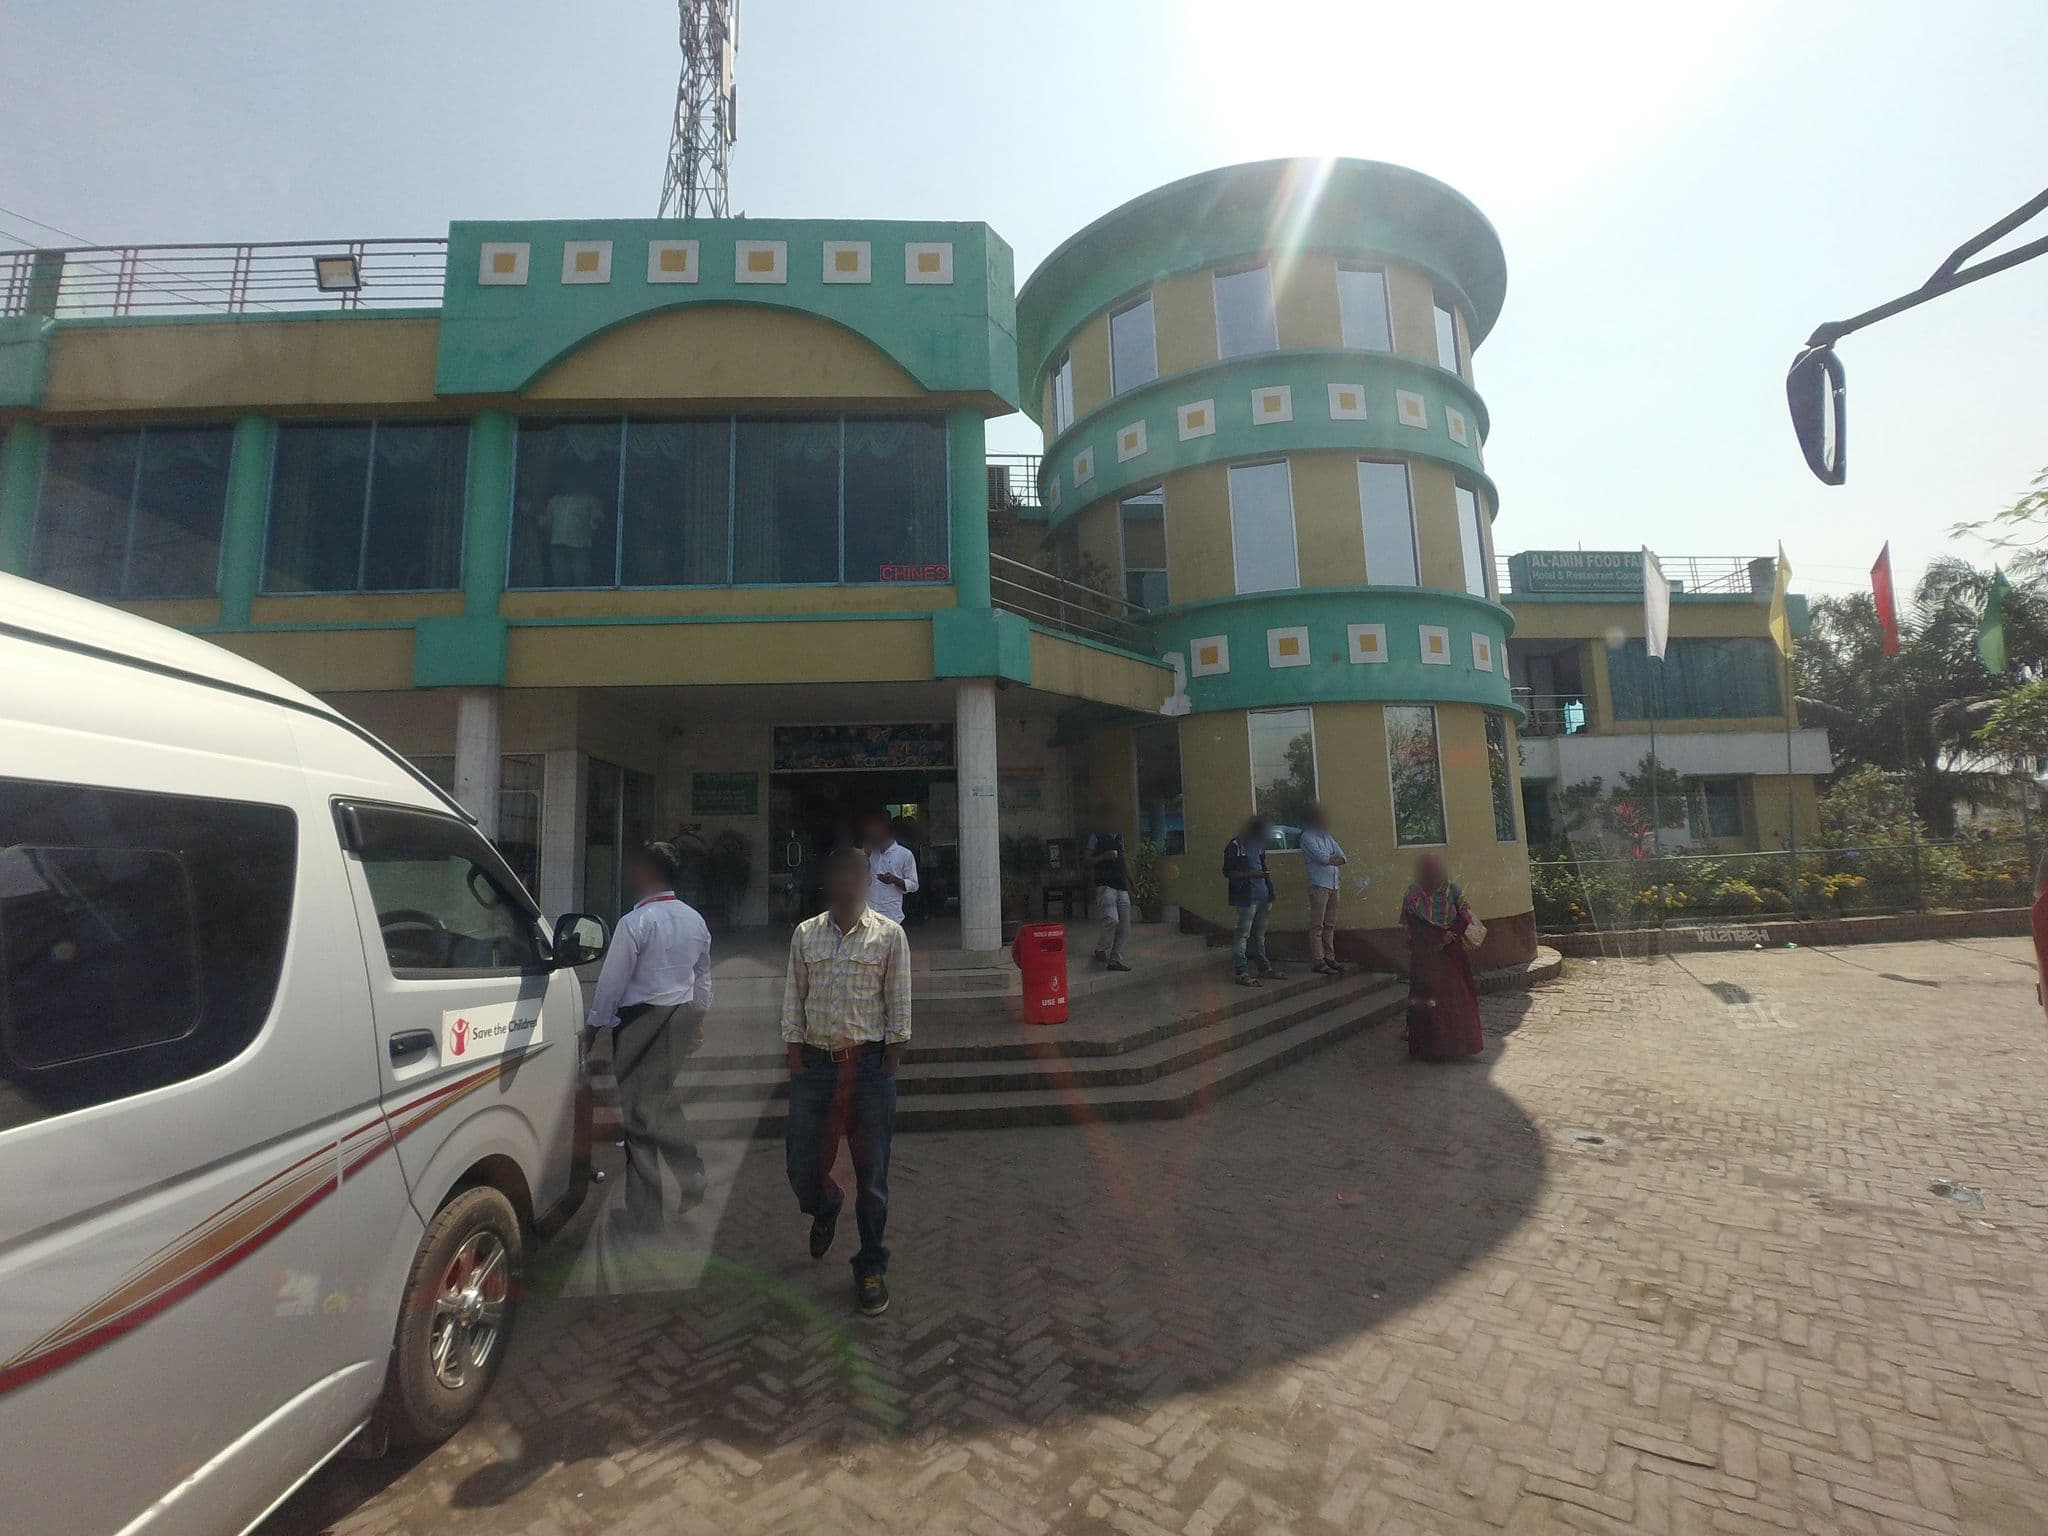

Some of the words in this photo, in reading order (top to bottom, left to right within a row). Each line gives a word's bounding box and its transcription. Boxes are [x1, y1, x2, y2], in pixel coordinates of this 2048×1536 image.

[1532, 554, 1584, 568] AL-AMIN
[1587, 554, 1620, 568] FOOD
[881, 566, 947, 581] CHINES
[1532, 571, 1556, 581] Hotel
[1566, 571, 1614, 581] Restaurant
[1041, 998, 1056, 1007] USE
[473, 1028, 493, 1040] Save
[493, 1023, 506, 1035] the
